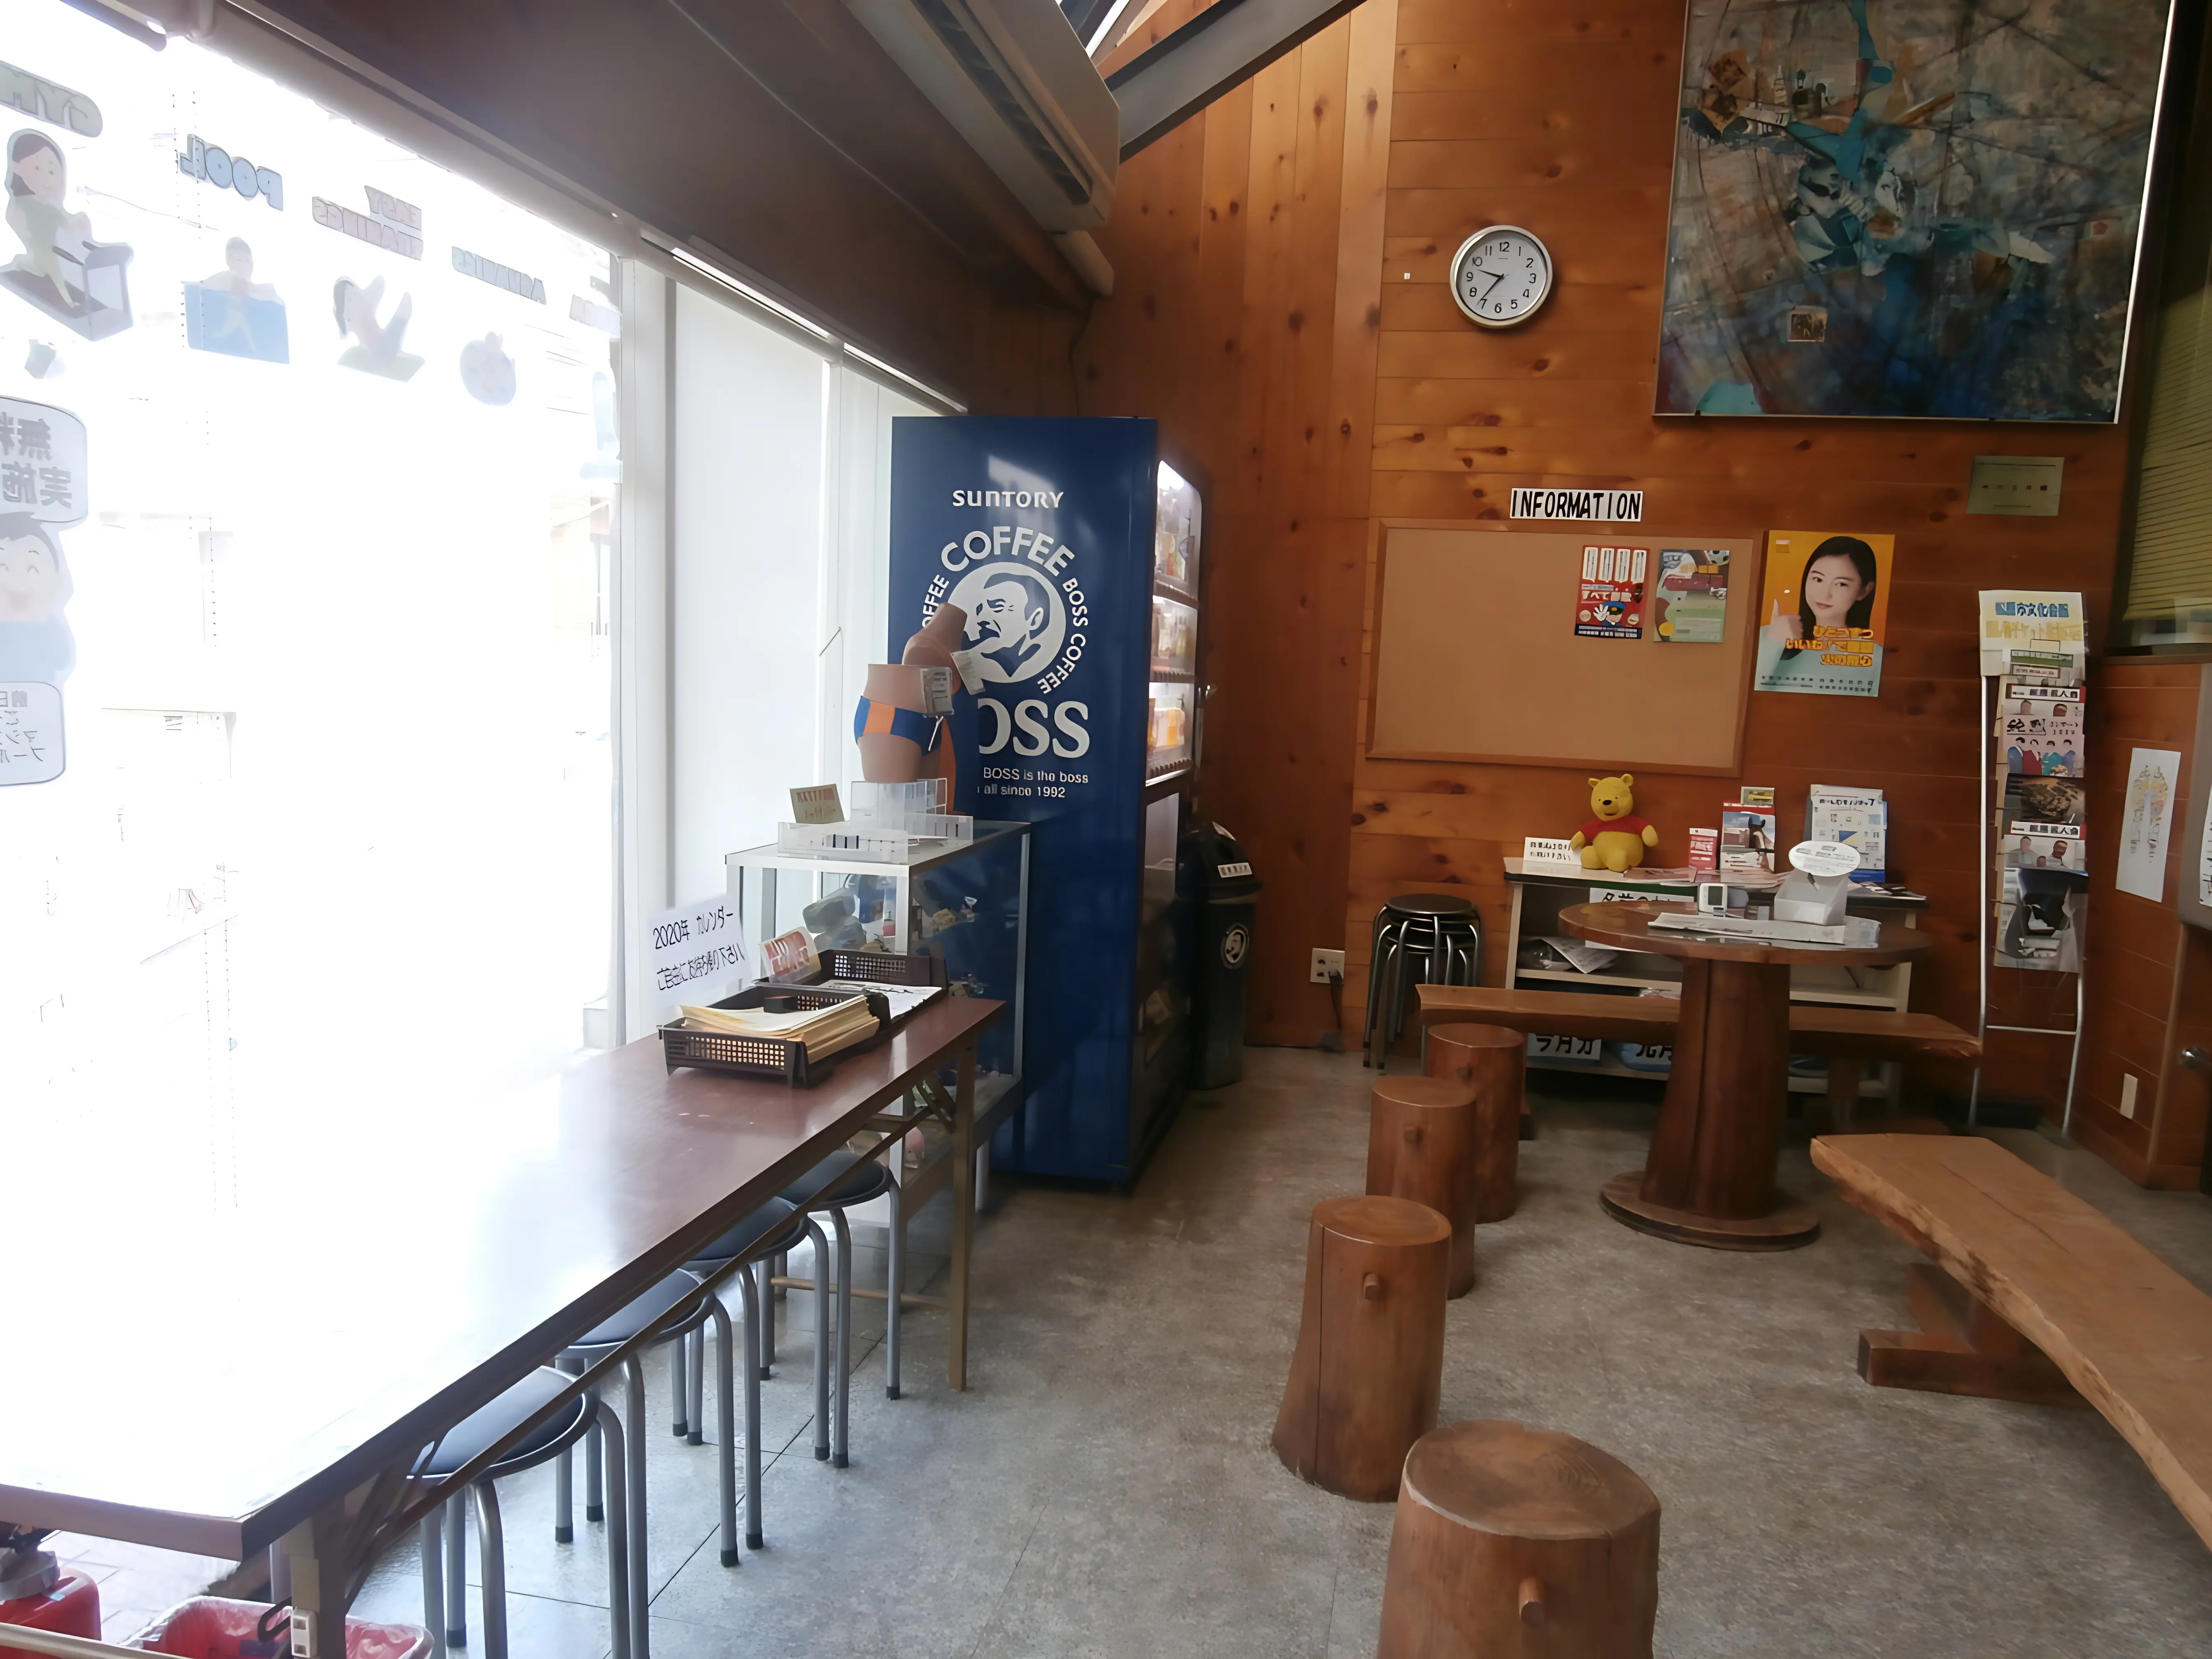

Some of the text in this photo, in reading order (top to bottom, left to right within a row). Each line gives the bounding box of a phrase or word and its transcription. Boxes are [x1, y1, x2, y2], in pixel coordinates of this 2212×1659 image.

[1485, 246, 1492, 256] 11
[1499, 242, 1509, 252] 12
[1519, 246, 1521, 256] 1
[1526, 258, 1534, 268] 2
[1466, 272, 1473, 281] 9
[1529, 273, 1536, 283] 3
[1469, 287, 1477, 297] 8
[1523, 289, 1529, 297] 4
[1480, 298, 1487, 309] 7
[1494, 303, 1502, 313] 6
[1511, 299, 1517, 309] 5
[953, 490, 1064, 508] SUNTORY
[1512, 490, 1641, 519] INFORMATION
[941, 526, 1075, 576] COFFEE
[1037, 578, 1088, 694] BOSS COFFEE
[984, 767, 1020, 780] BOSS
[1024, 769, 1033, 780] is
[1060, 771, 1088, 783] boss
[1037, 787, 1065, 798] 1992
[653, 920, 690, 949] 2020年
